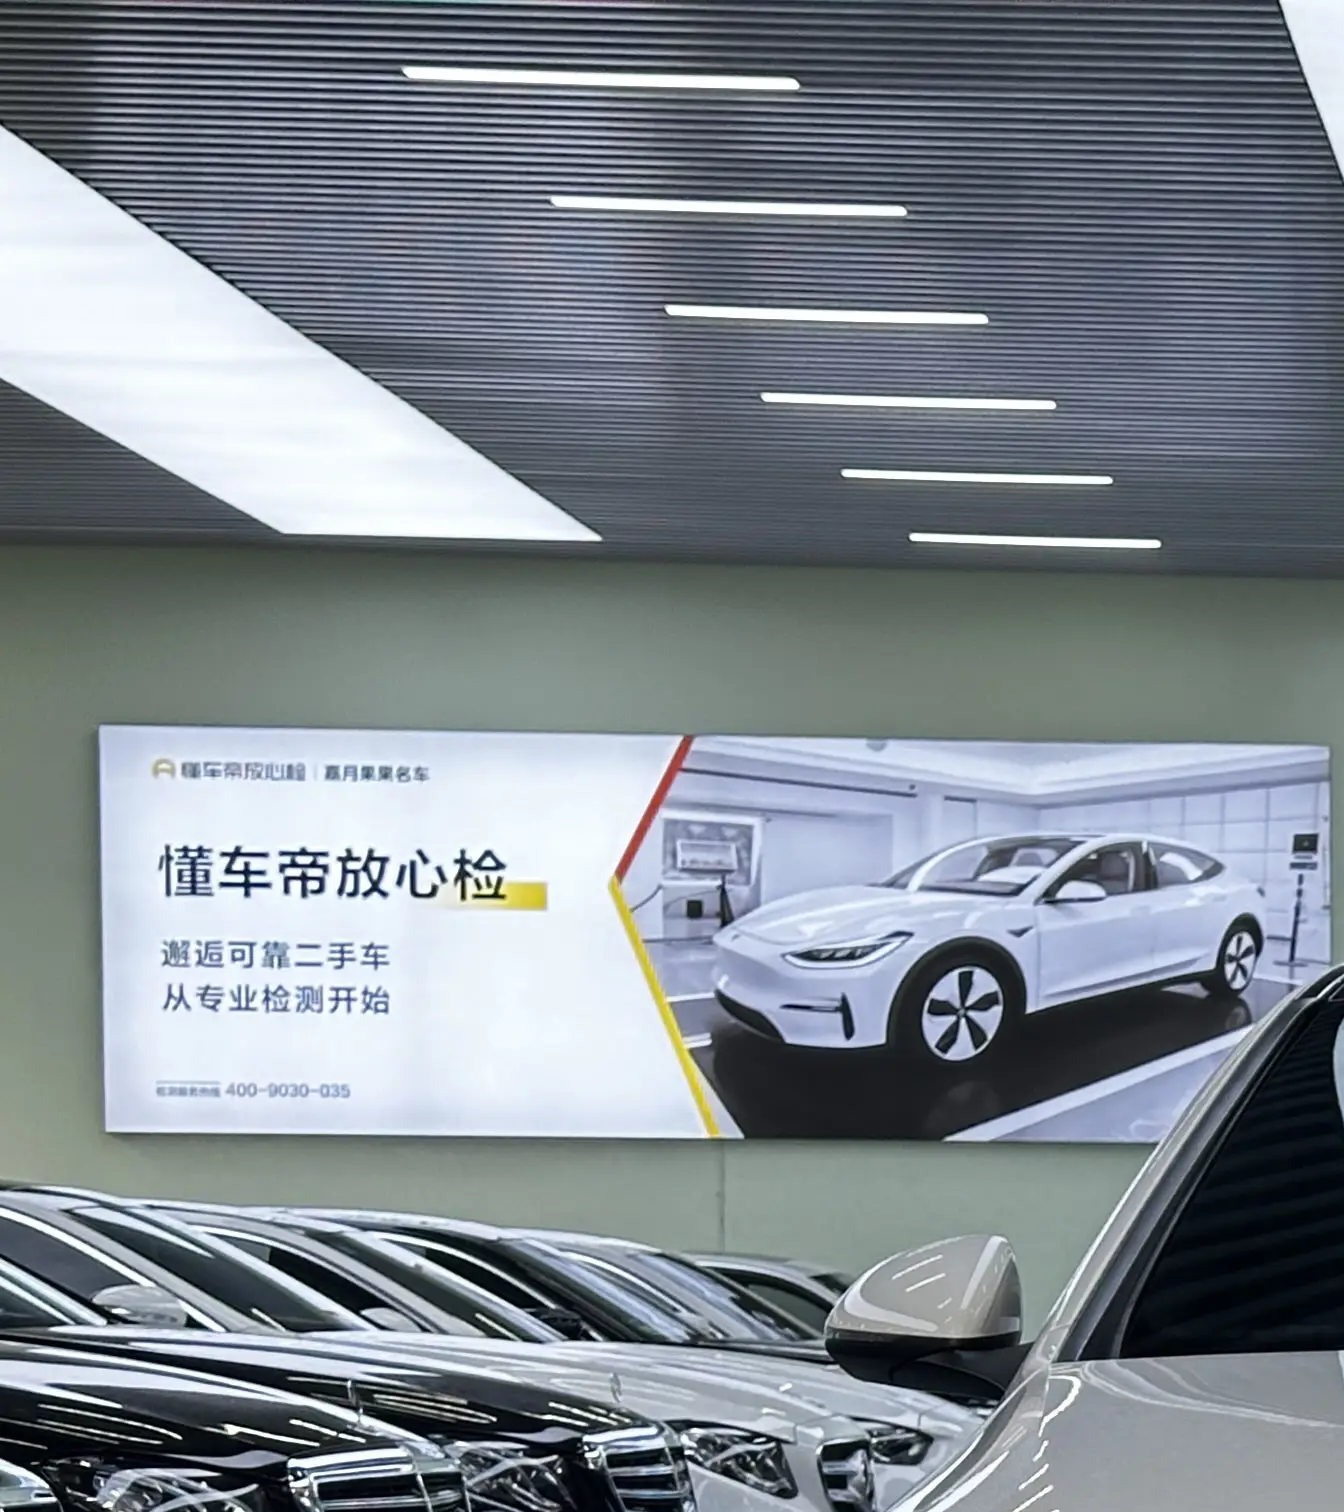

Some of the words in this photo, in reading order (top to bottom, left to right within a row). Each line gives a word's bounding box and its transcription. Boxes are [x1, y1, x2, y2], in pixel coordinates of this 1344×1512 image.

[157, 844, 508, 902] 懂车帝放心检
[160, 939, 391, 971] 邂逅可靠二手车
[161, 983, 391, 1016] 从专业检测开始
[224, 1082, 352, 1099] 400-9030-035
